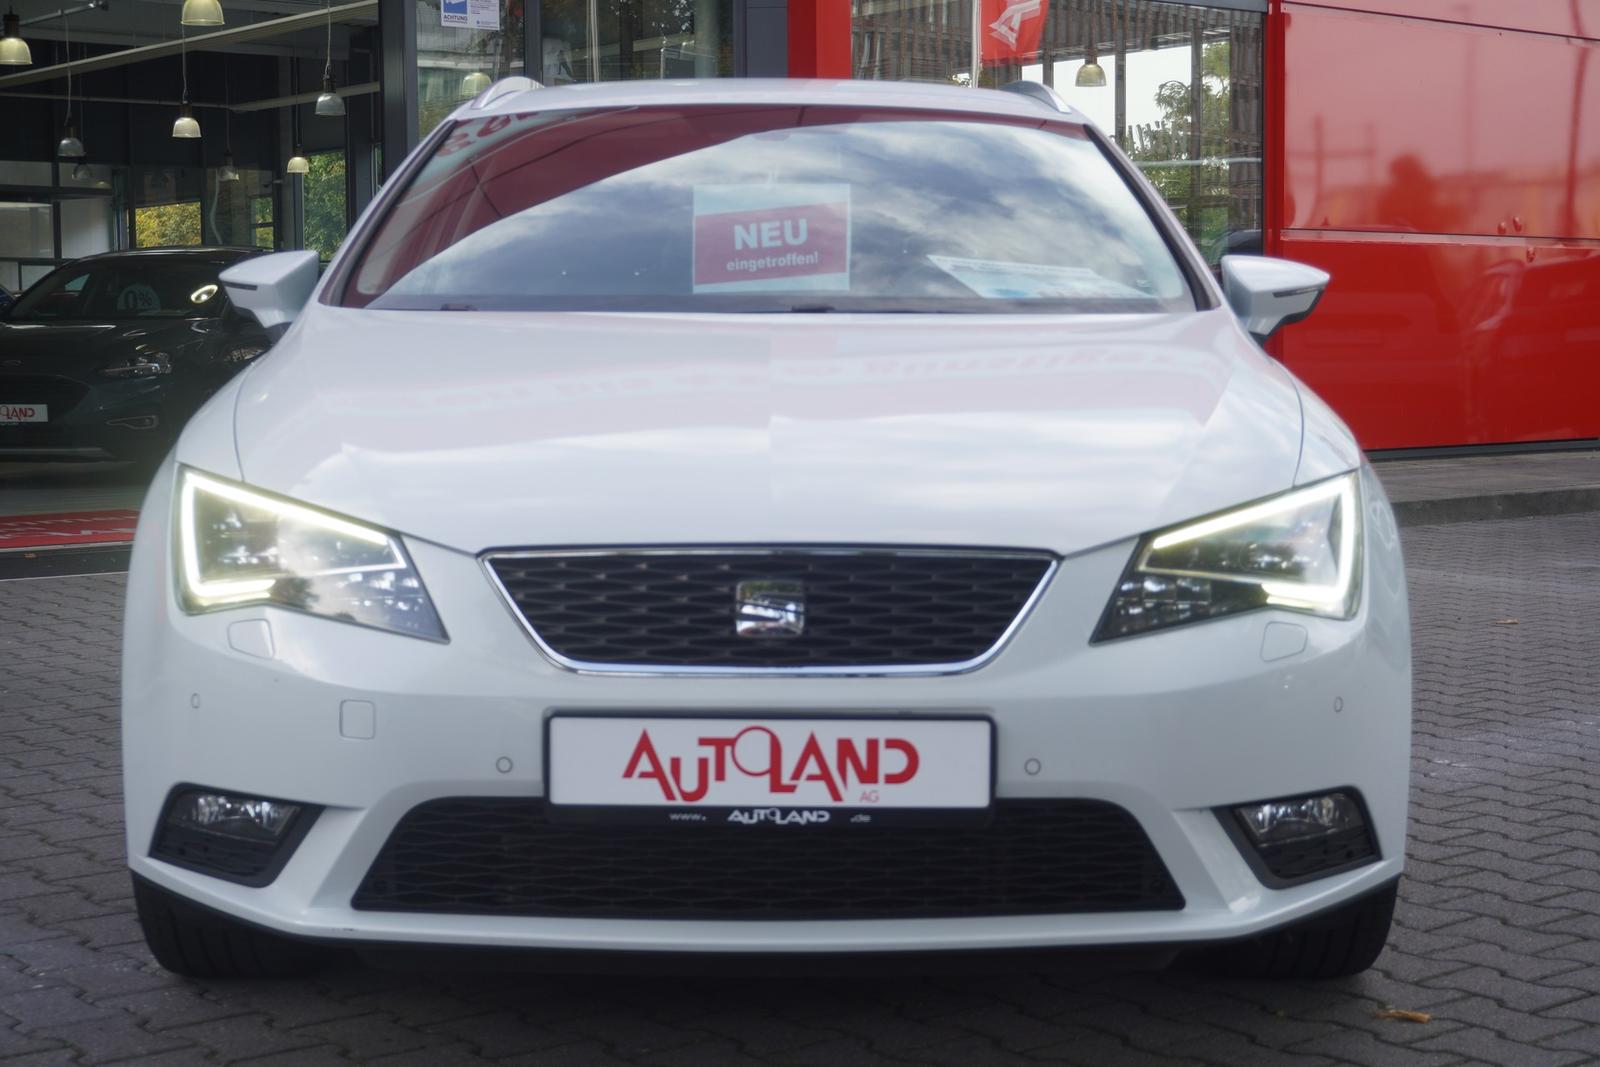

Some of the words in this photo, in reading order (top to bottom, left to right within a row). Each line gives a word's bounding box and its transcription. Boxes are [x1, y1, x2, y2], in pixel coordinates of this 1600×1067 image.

[733, 218, 808, 250] NEU
[726, 251, 819, 272] eingetroffen!
[621, 725, 921, 803] AUTOLAND
[859, 790, 880, 803] AG
[669, 812, 707, 821] www.
[727, 808, 831, 825] AUTOLAND
[850, 812, 871, 823] .de
